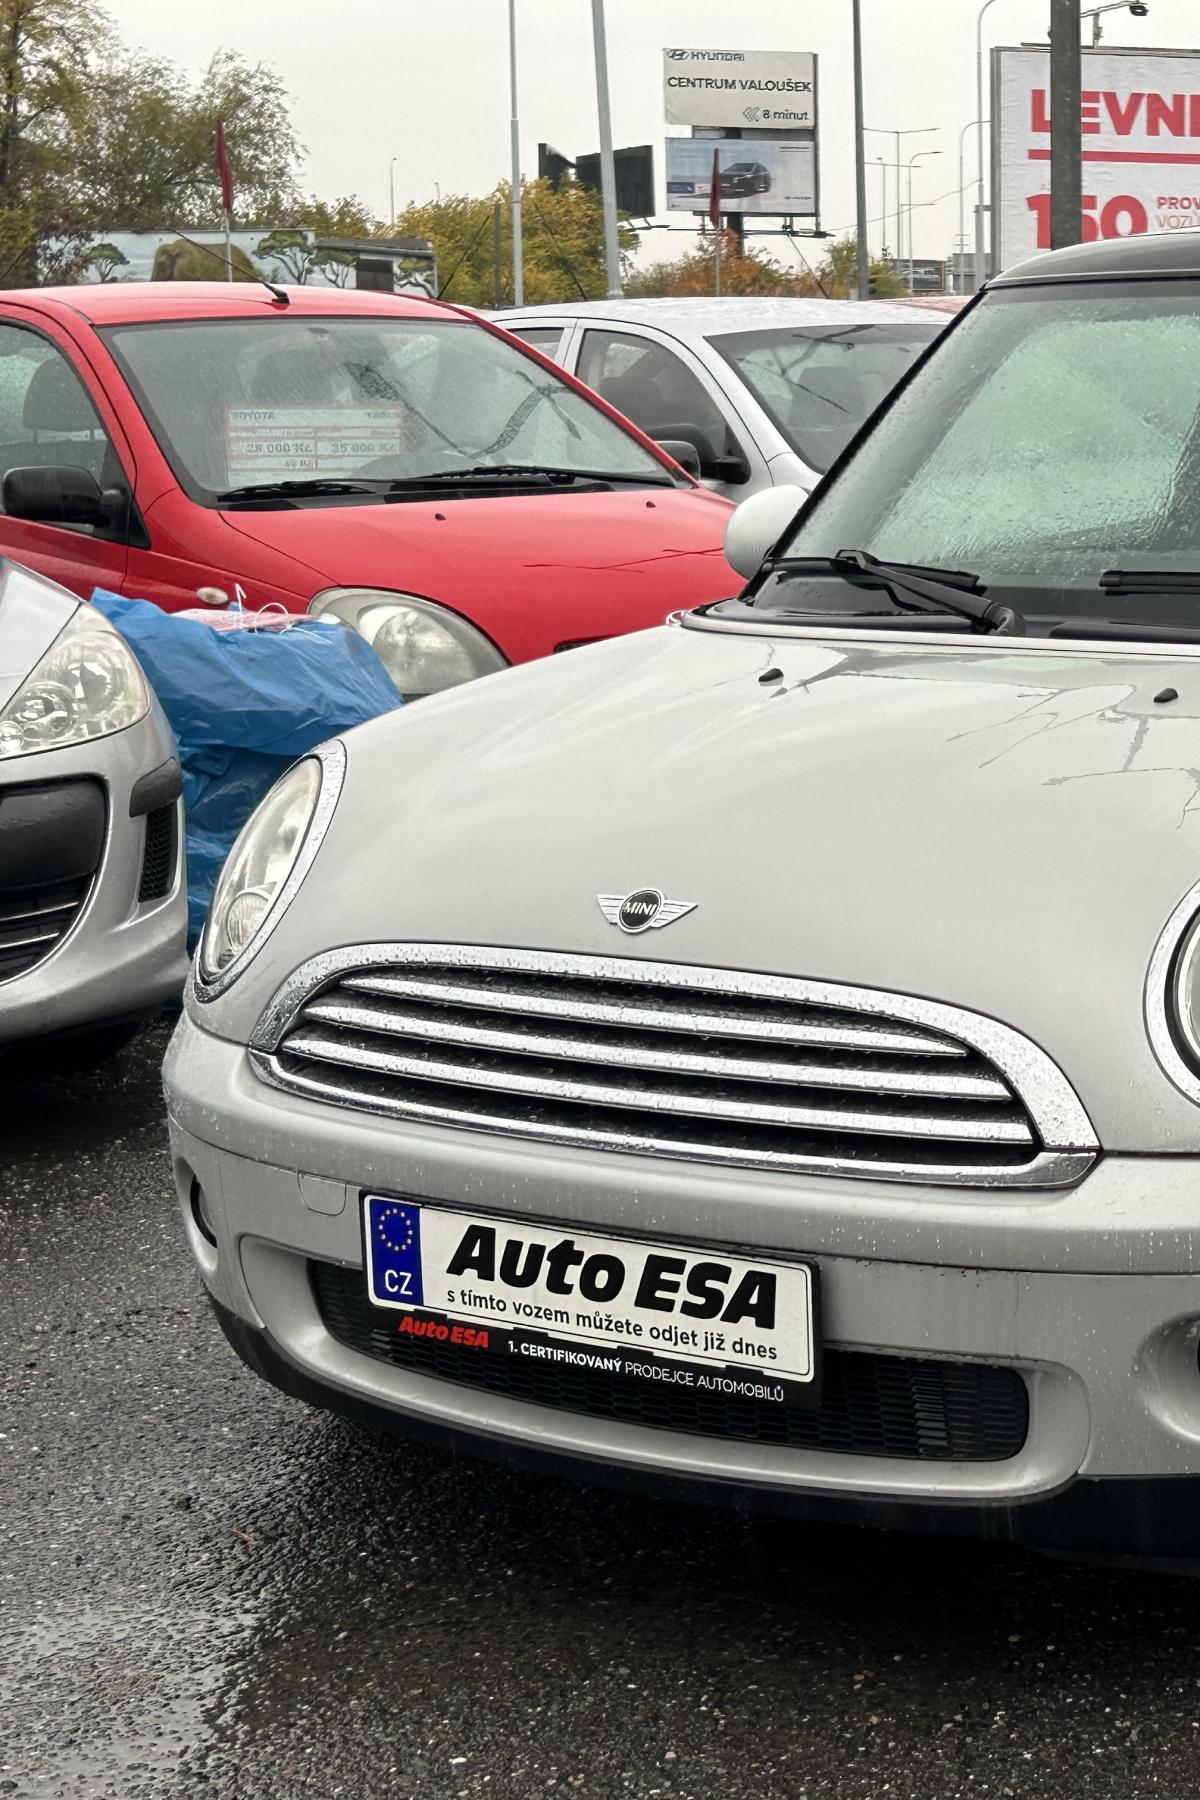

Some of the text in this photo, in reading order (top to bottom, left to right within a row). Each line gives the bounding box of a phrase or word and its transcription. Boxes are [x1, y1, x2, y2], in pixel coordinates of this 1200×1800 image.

[667, 76, 812, 93] CENTRUM VALOUŠEK
[231, 411, 276, 421] TOYOTA
[623, 901, 658, 916] MINI
[384, 1269, 413, 1296] CZ
[446, 1224, 777, 1330] Auto ESA
[398, 1315, 490, 1349] Auto ESA
[447, 1289, 778, 1360] s tímto vozem můžete odjet již dnes
[508, 1341, 784, 1402] 1. CERTIFIKOVANÝ PRODEJCE AUTOMOBILŮ
